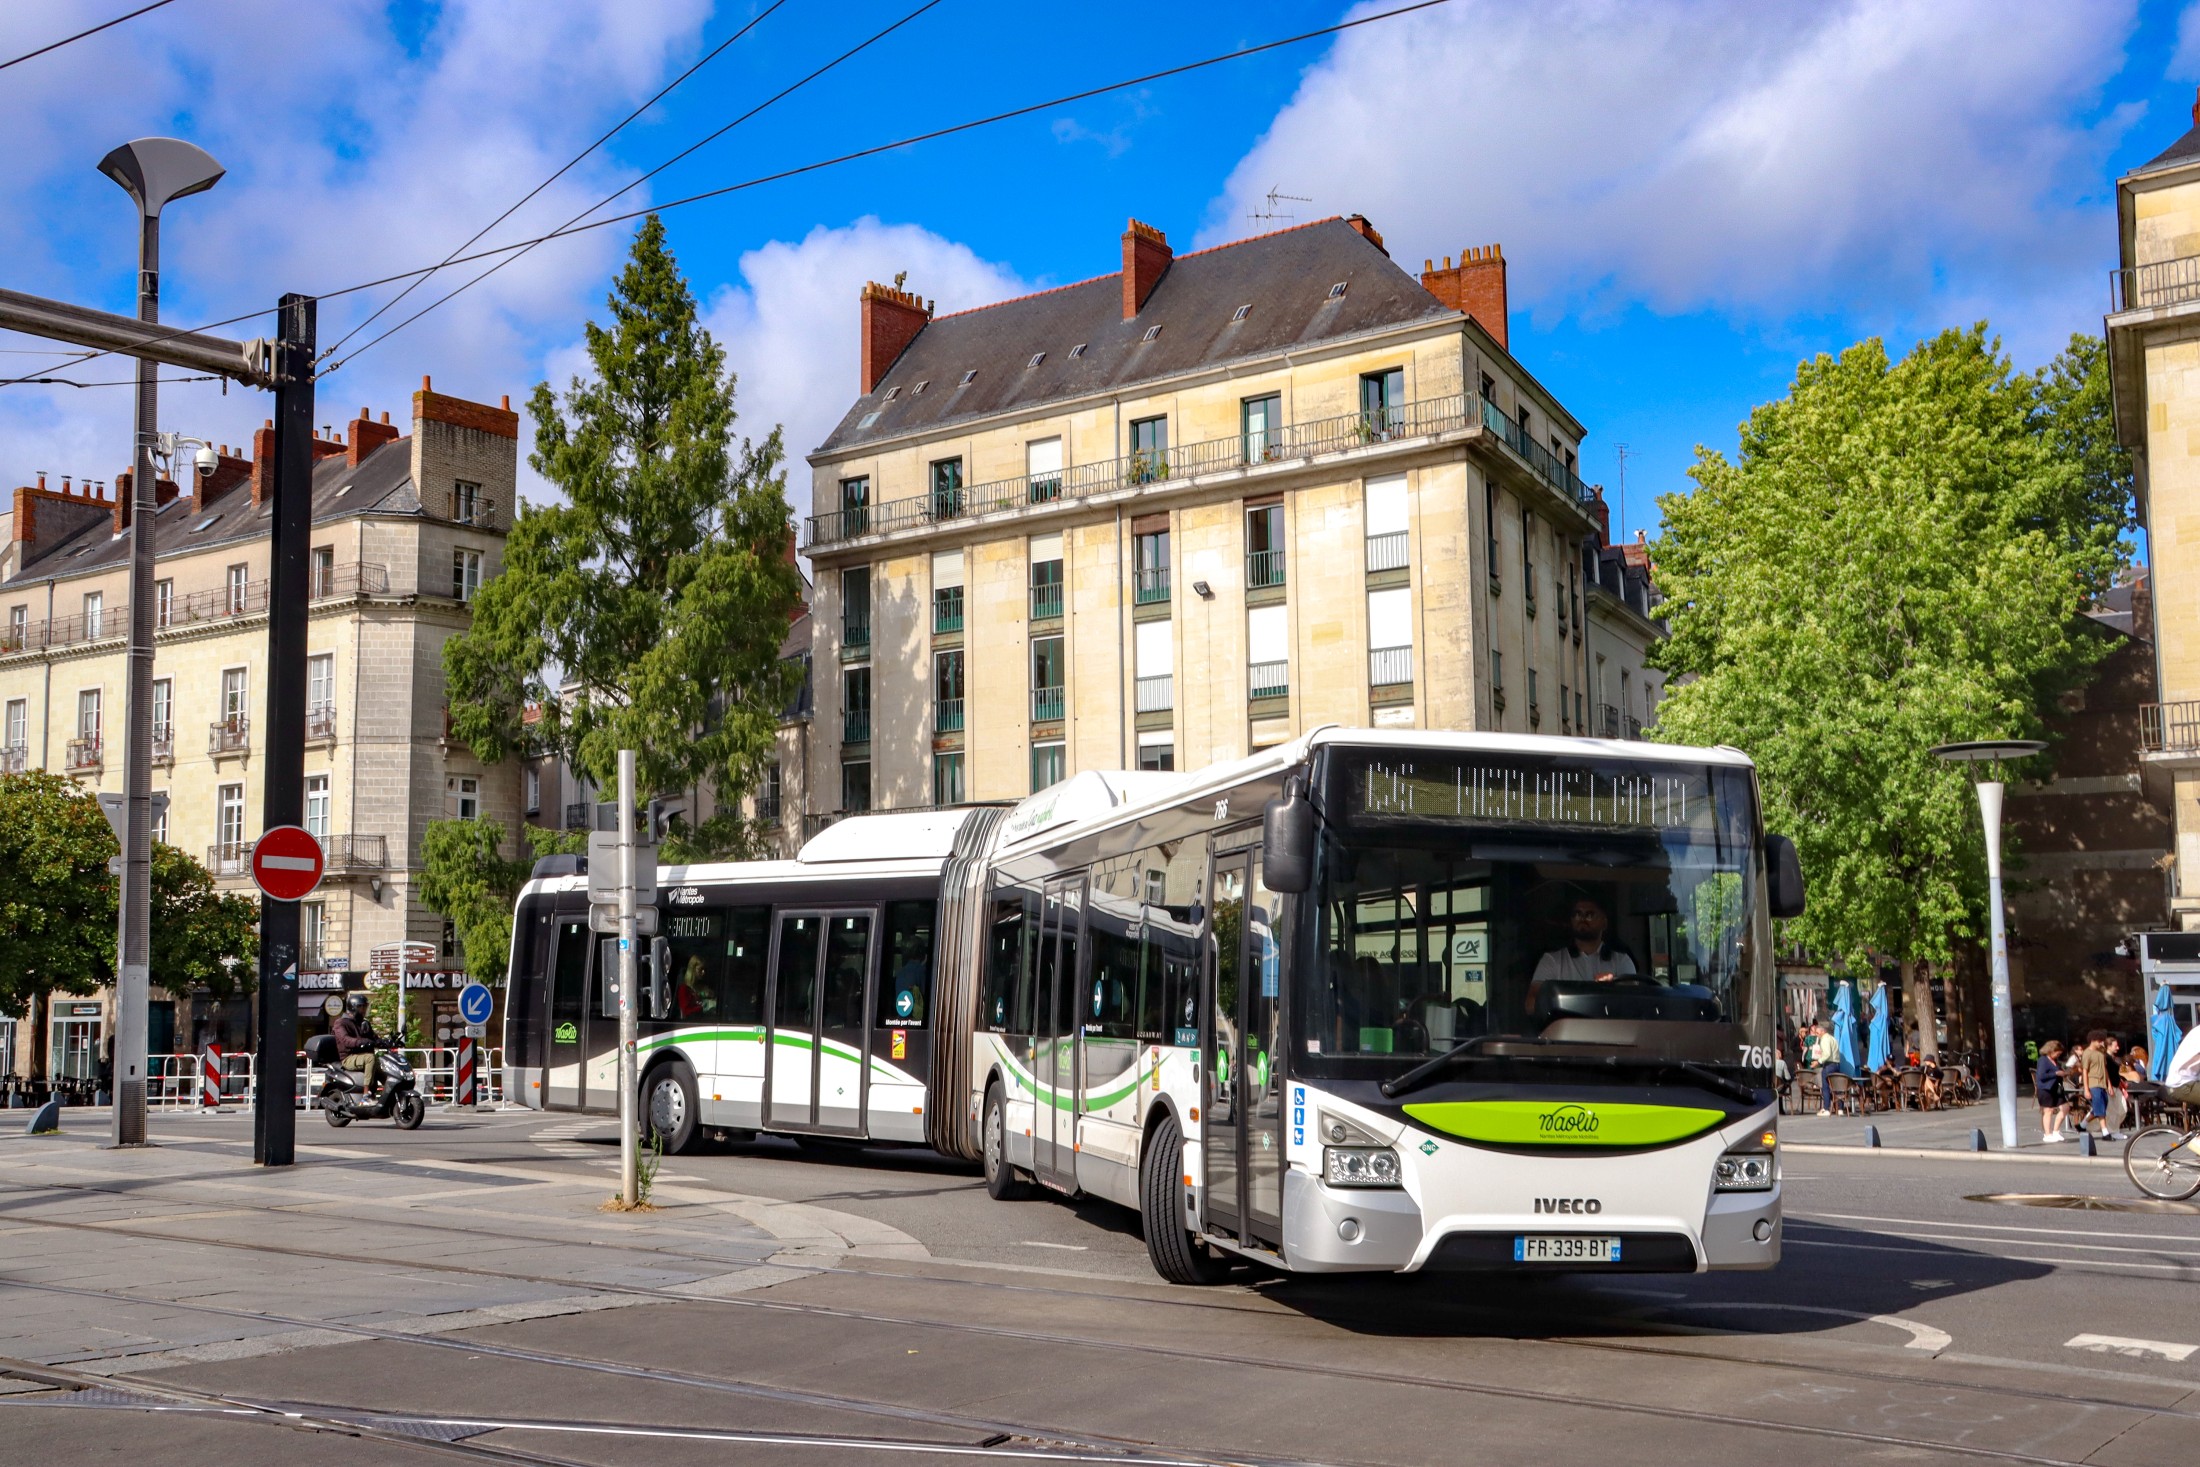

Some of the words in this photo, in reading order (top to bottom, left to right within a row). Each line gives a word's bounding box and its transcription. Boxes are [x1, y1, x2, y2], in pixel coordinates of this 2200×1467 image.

[1214, 798, 1229, 821] 766
[677, 887, 698, 896] Nantes
[676, 894, 705, 906] Métropole
[406, 972, 446, 988] MAC
[1738, 1044, 1772, 1069] 766
[1534, 1198, 1602, 1214] IVECO
